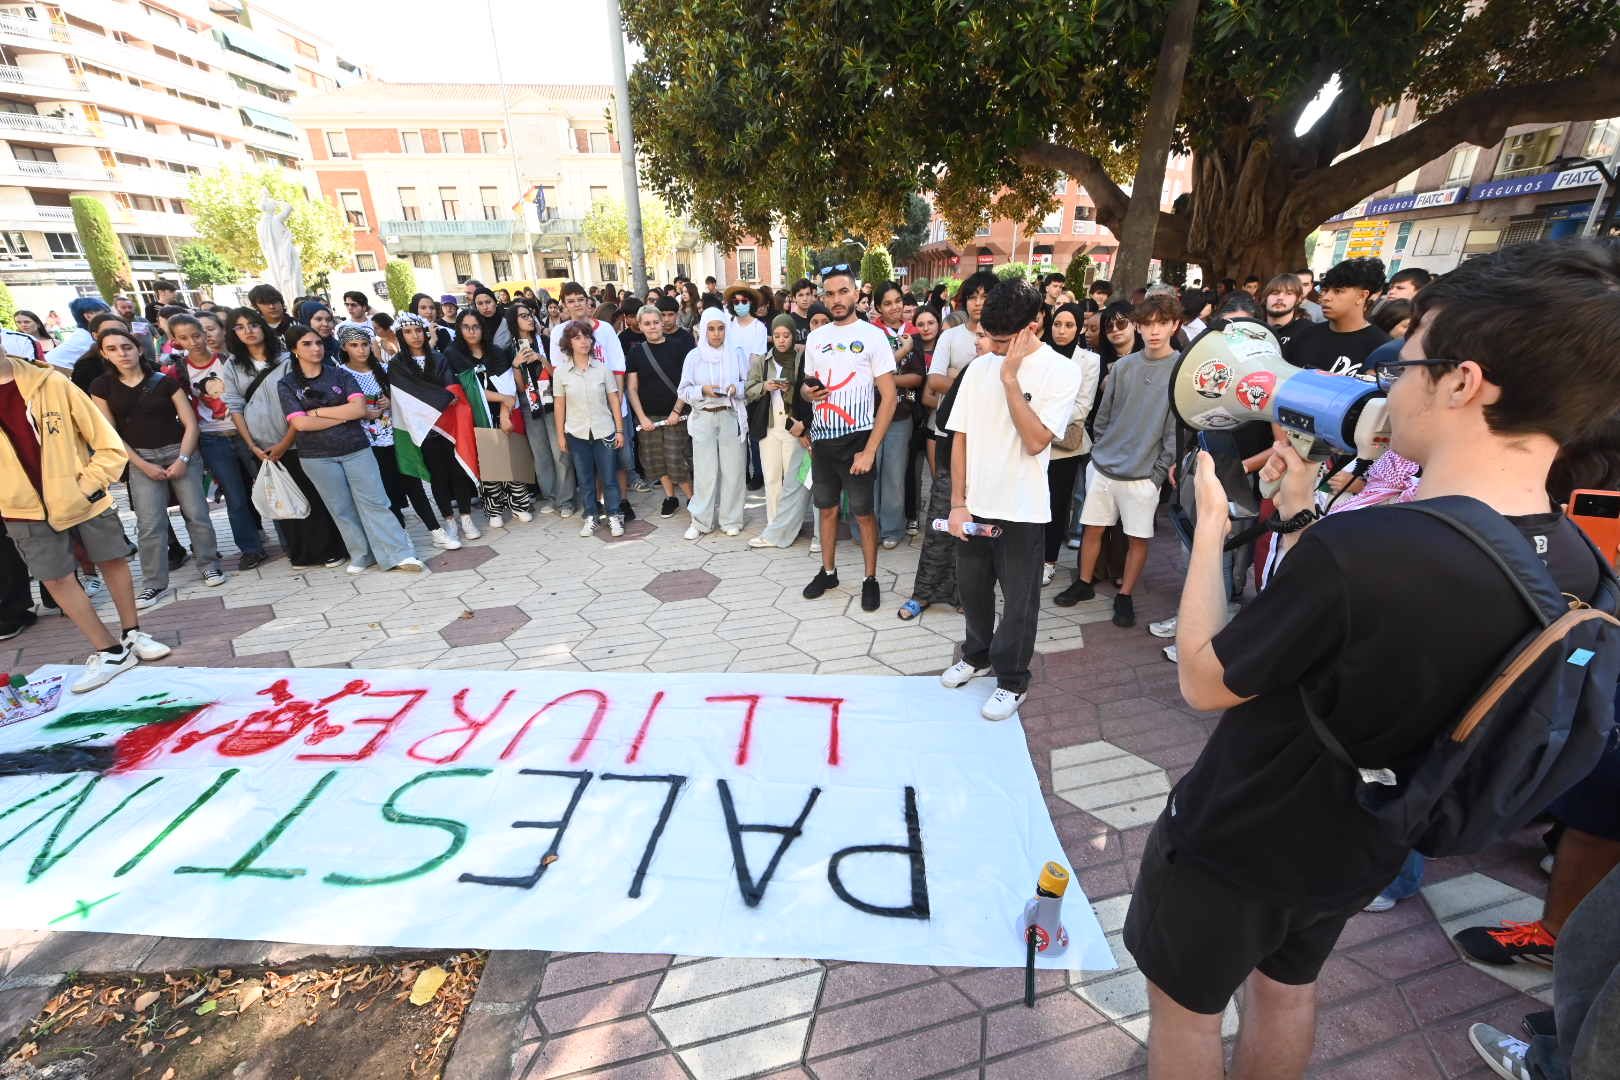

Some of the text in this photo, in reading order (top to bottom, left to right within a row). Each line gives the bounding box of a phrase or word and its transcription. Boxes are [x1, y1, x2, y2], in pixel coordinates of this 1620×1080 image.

[1372, 193, 1442, 213] SEGUROS FIATC
[1480, 169, 1599, 198] SEGUROS FIATC
[296, 687, 845, 767] LLIURE
[0, 768, 932, 921] PALESTIN
